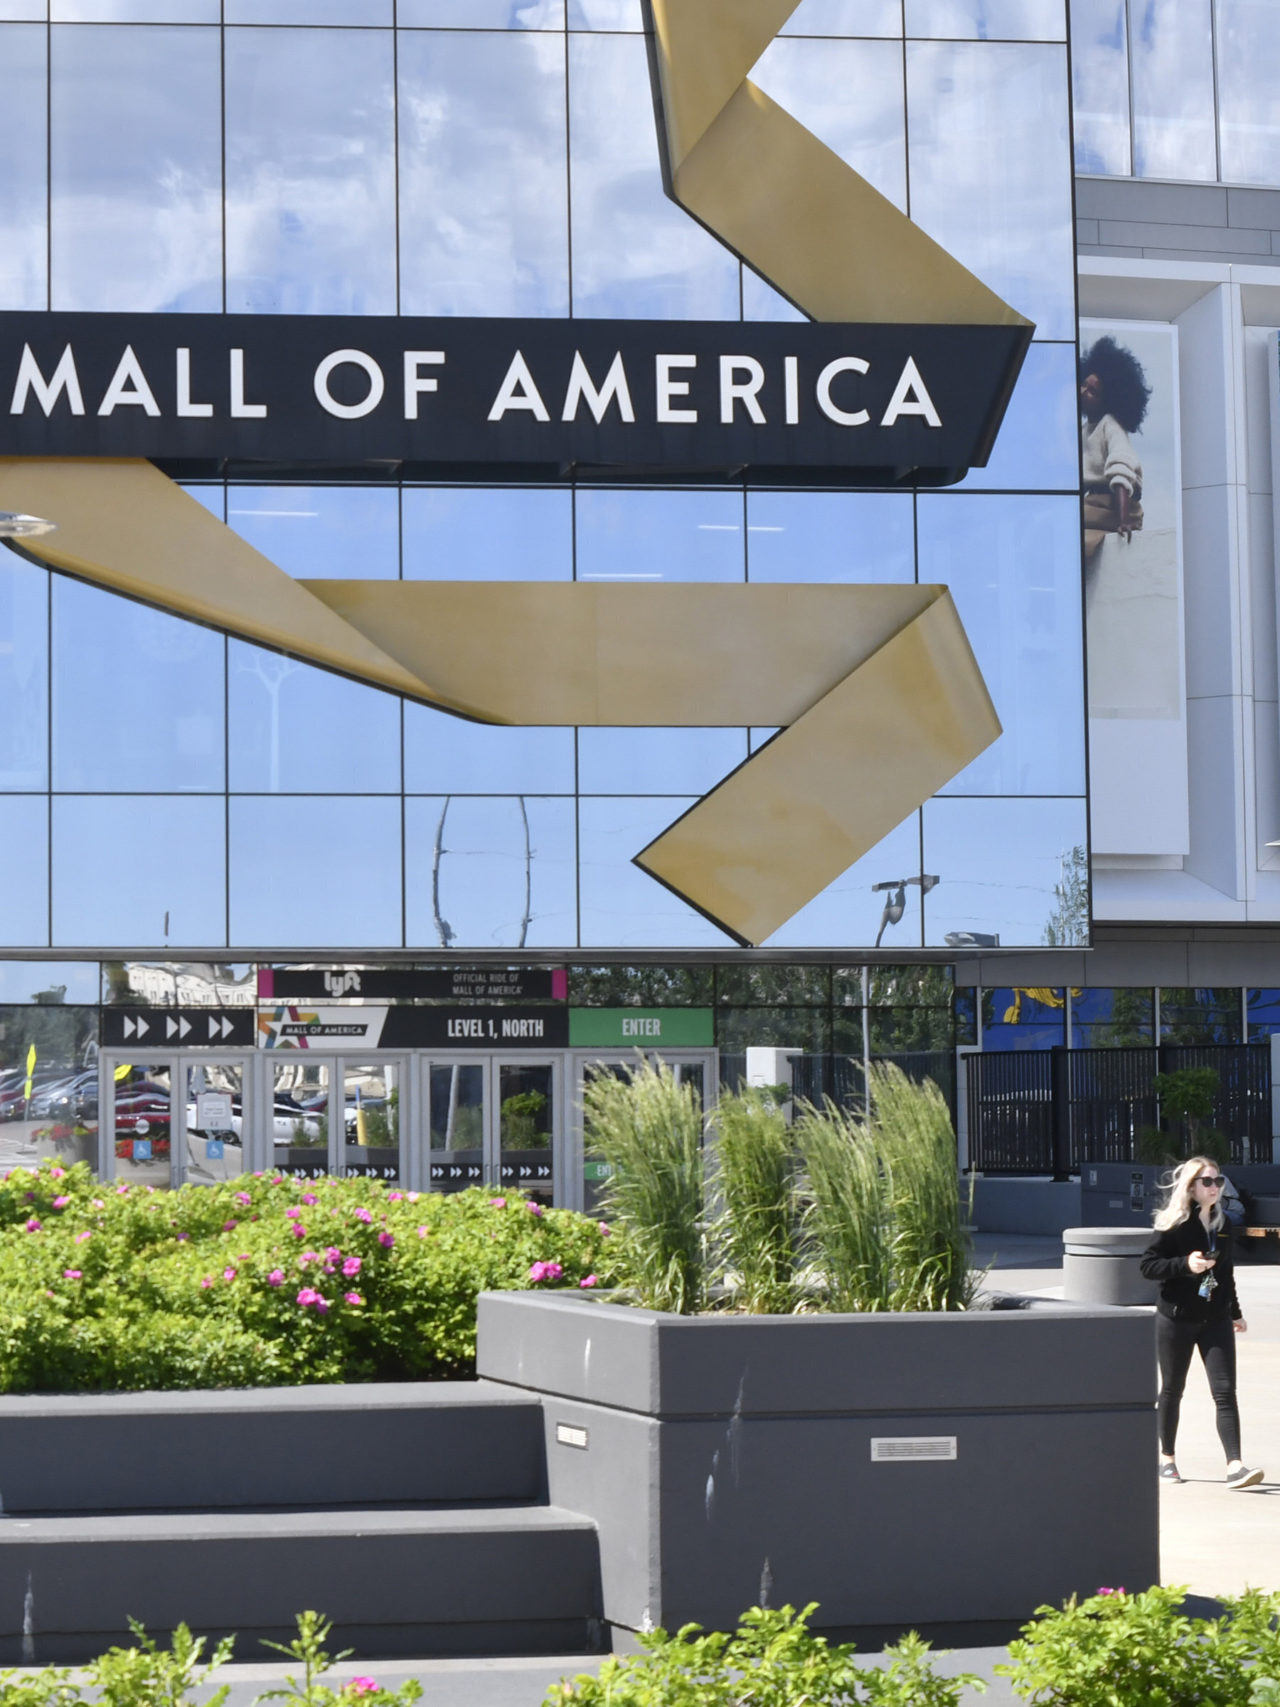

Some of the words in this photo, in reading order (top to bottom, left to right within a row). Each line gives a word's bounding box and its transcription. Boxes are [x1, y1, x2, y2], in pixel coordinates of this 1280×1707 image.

[10, 343, 267, 418] MALL
[314, 349, 446, 420] OF
[487, 350, 943, 427] AMERICA
[324, 971, 361, 997] lyft
[453, 973, 487, 983] OFFICIAL
[489, 973, 507, 983] RIDE
[509, 973, 520, 983] OF
[452, 985, 473, 995] MALL
[475, 985, 486, 995] OF
[286, 1026, 308, 1035] MALL
[310, 1026, 322, 1035] OF
[325, 1026, 364, 1035] AMERICA
[448, 1019, 485, 1037] LEVEL
[487, 1019, 498, 1039] 1,
[502, 1019, 544, 1037] NORTH
[622, 1018, 661, 1036] ENTER
